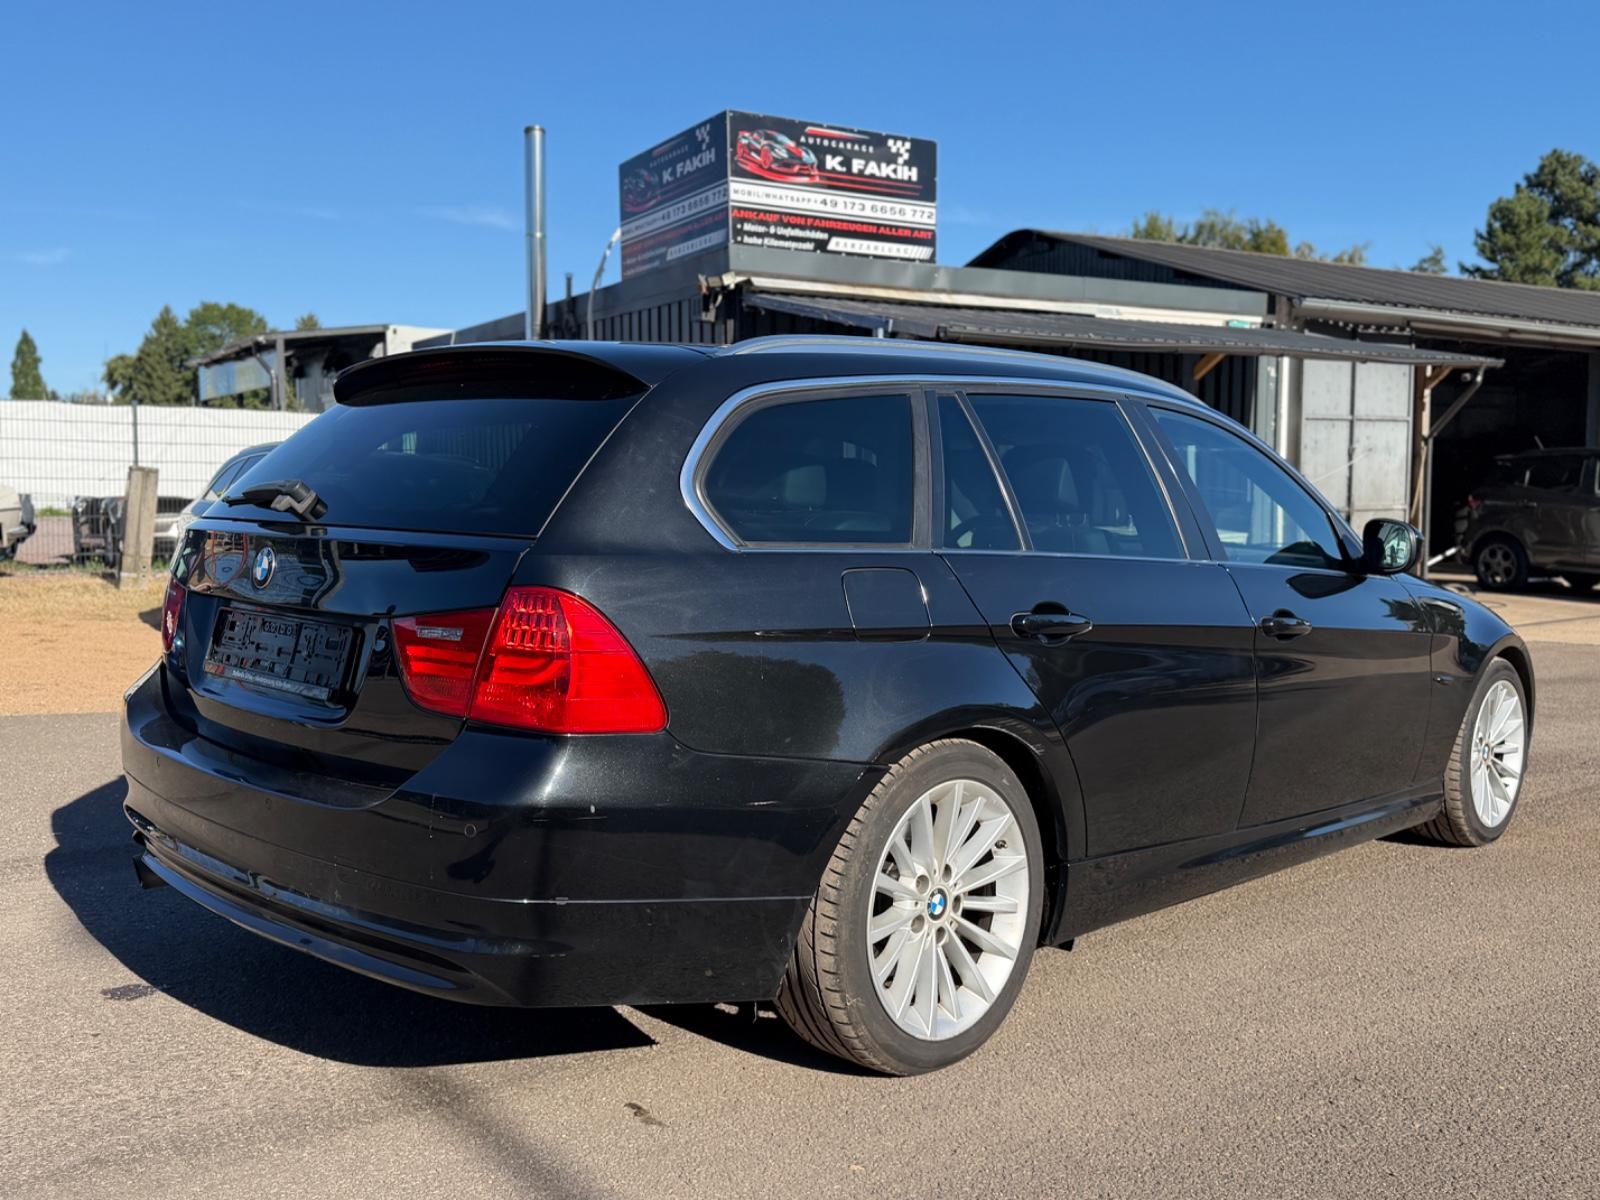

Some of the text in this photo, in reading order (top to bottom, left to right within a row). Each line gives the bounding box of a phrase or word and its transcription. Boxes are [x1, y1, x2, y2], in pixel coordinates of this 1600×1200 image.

[825, 154, 847, 173] K.
[842, 200, 866, 212] 173
[870, 201, 907, 217] 6656
[911, 207, 935, 220] 772
[731, 208, 933, 239] ANKAUF VON FAHRZEUGEN ALLER ART
